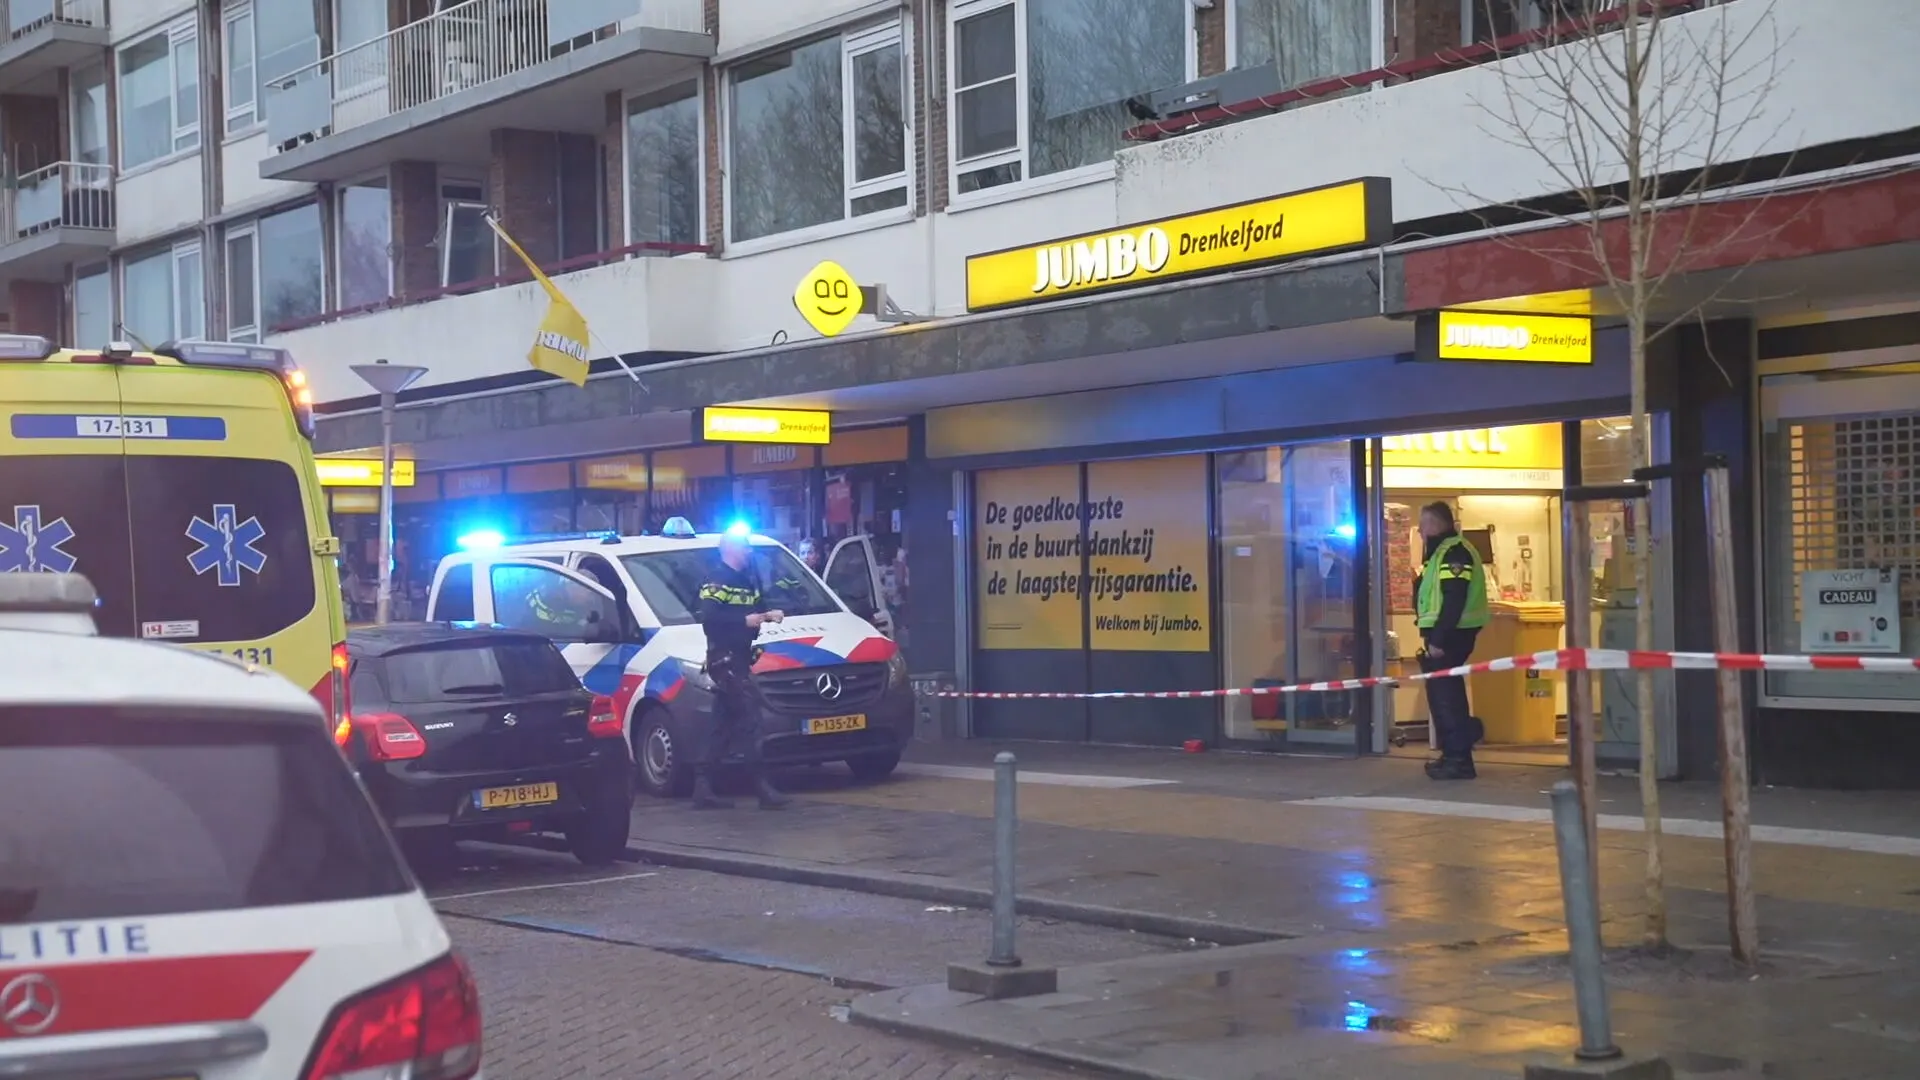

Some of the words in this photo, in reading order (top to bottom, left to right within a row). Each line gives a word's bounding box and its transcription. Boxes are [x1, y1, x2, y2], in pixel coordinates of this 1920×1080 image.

[1033, 227, 1170, 292] JUMBO
[1179, 214, 1284, 256] Drenkelford
[1445, 326, 1528, 350] JUMBO
[1532, 334, 1587, 348] Drenkelford
[93, 420, 153, 434] 17-131
[985, 501, 1007, 524] De
[986, 535, 1002, 560] in
[1008, 535, 1028, 560] de
[1034, 533, 1081, 558] buurt
[1087, 528, 1154, 563] dankzij
[987, 571, 1007, 595] de
[1823, 591, 1873, 603] CADEAU
[1095, 615, 1140, 631] Welkom
[1143, 615, 1158, 636] bij
[1160, 616, 1202, 633] Jumbo.
